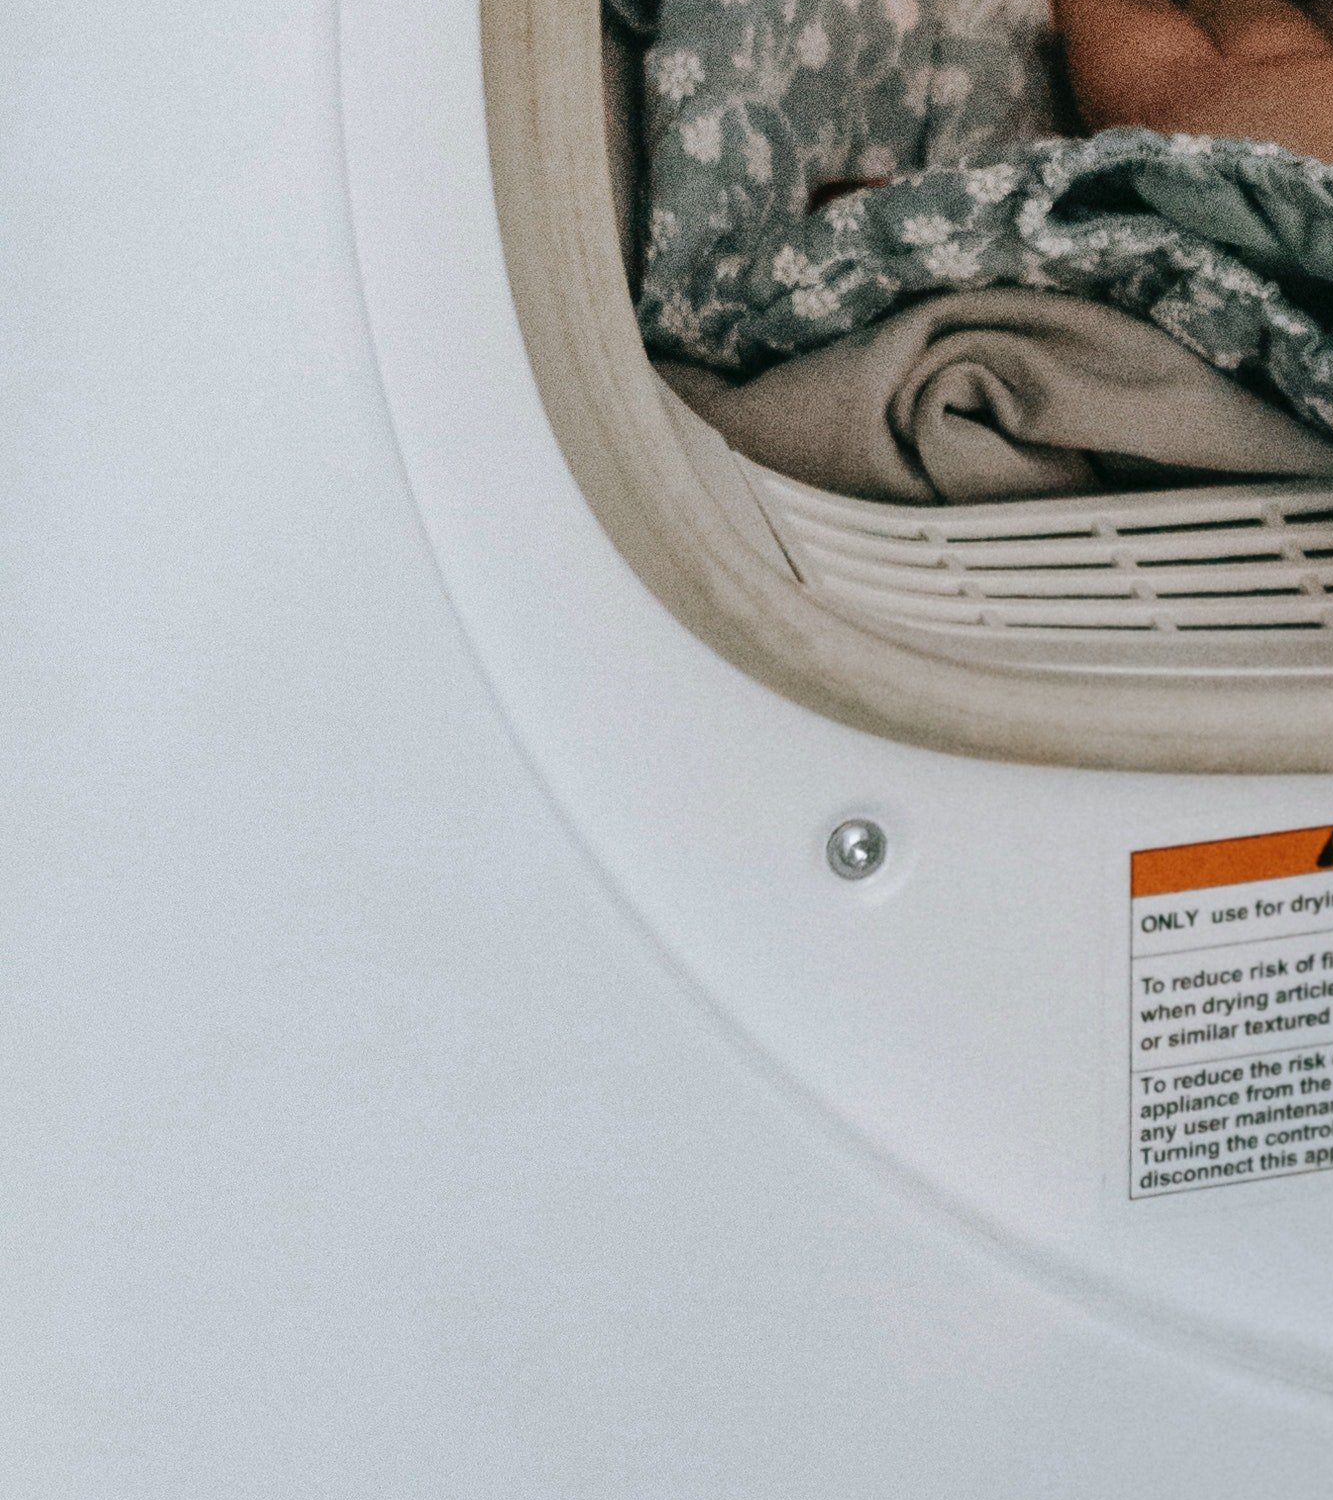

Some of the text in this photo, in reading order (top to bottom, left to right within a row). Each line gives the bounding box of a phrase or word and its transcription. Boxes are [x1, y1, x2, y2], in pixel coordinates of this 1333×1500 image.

[1141, 910, 1198, 933] ONLY
[1211, 907, 1248, 924] use
[1255, 900, 1283, 917] for
[1141, 976, 1165, 995] To
[1172, 968, 1243, 991] reduce
[1250, 960, 1288, 978] risk
[1295, 954, 1315, 974] of
[1140, 1003, 1196, 1023] when
[1202, 992, 1269, 1015] drying
[1140, 1035, 1161, 1051] or
[1168, 1024, 1238, 1047] similar
[1244, 1008, 1330, 1035] textured
[1141, 1076, 1166, 1095] To
[1173, 1067, 1243, 1089] reduce
[1249, 1061, 1281, 1079] the
[1289, 1053, 1325, 1071] risk
[1140, 1091, 1240, 1120] appliance
[1245, 1083, 1294, 1101] from
[1299, 1077, 1332, 1095] the
[1140, 1126, 1176, 1143] any
[1184, 1117, 1228, 1135] user
[1140, 1141, 1220, 1164] Turning
[1226, 1134, 1258, 1152] the
[1139, 1157, 1253, 1189] disconnect
[1259, 1153, 1298, 1171] this
